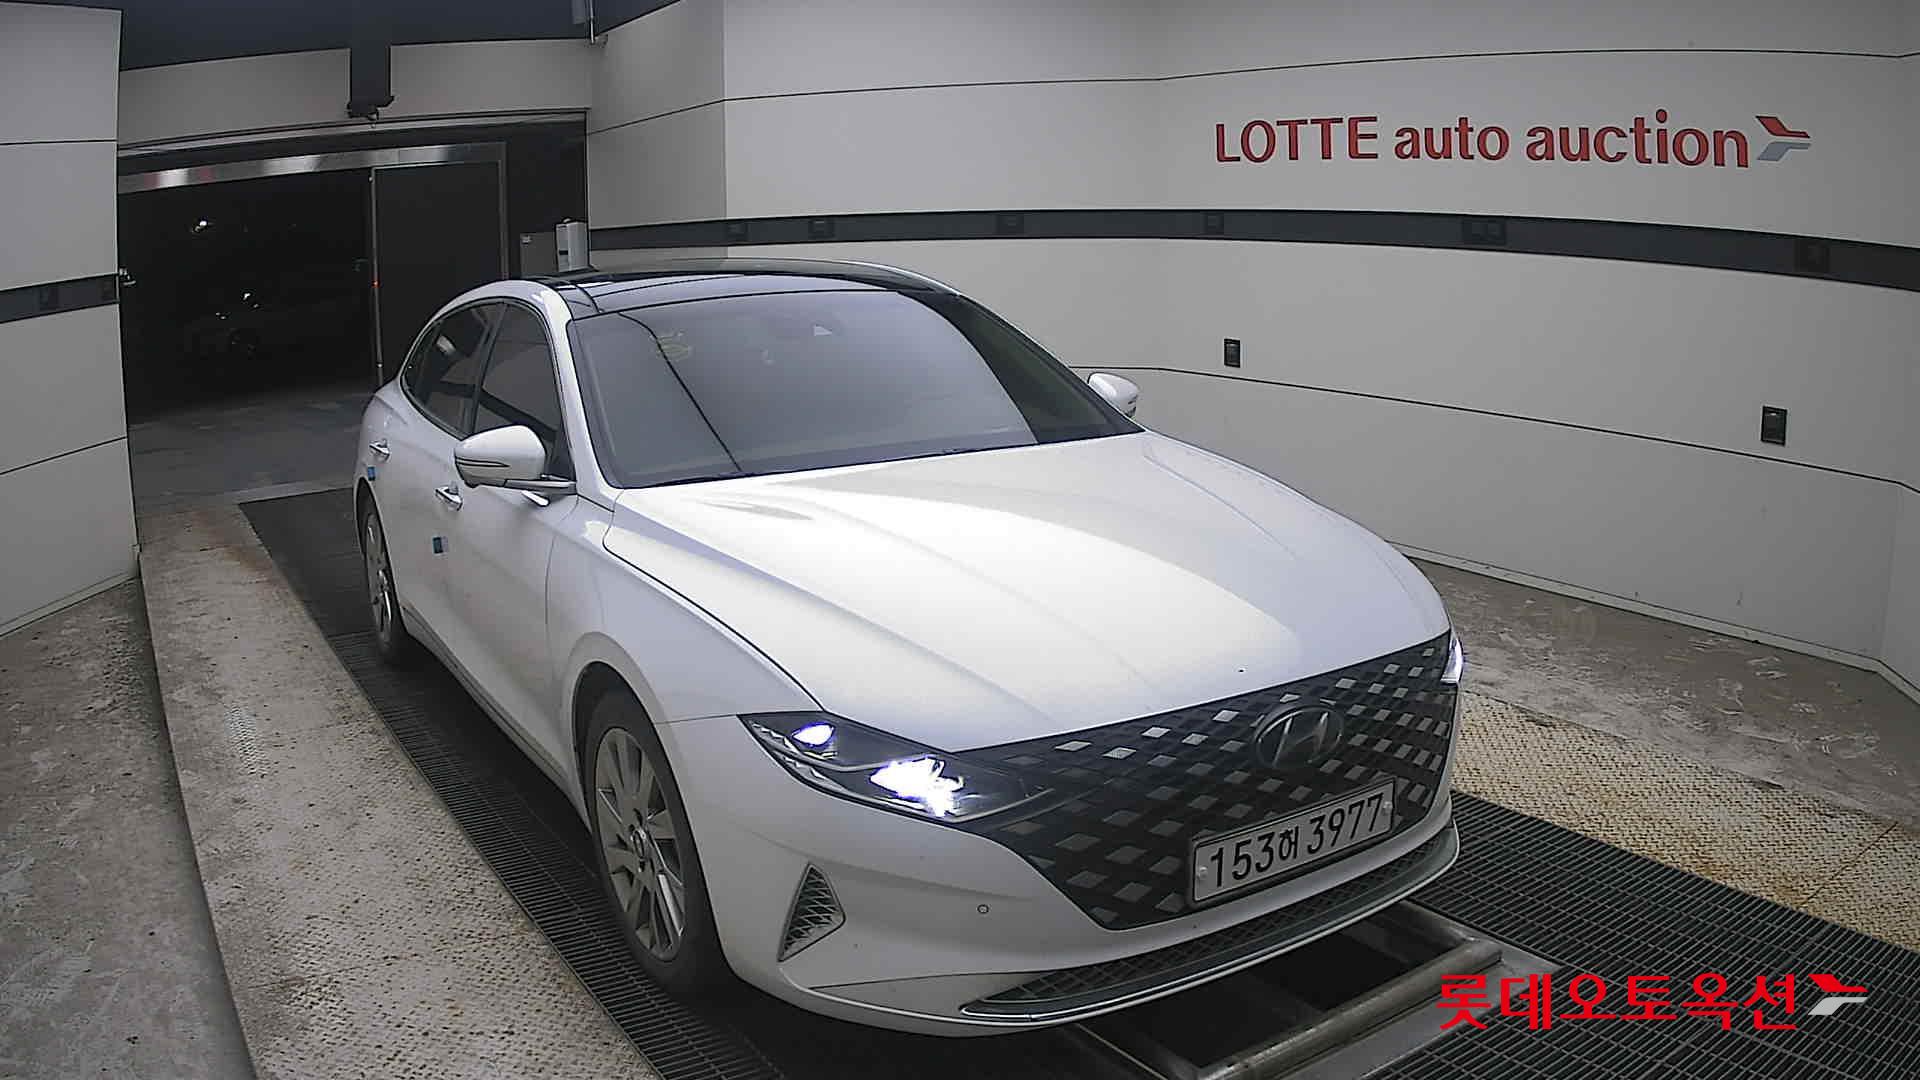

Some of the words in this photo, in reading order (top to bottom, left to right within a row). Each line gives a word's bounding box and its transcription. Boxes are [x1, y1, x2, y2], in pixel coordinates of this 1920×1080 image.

[1215, 115, 1379, 164] LOTTE
[1394, 115, 1510, 162] auto
[1525, 108, 1750, 169] auction
[1210, 825, 1299, 888] 153허
[1307, 792, 1384, 854] 3977
